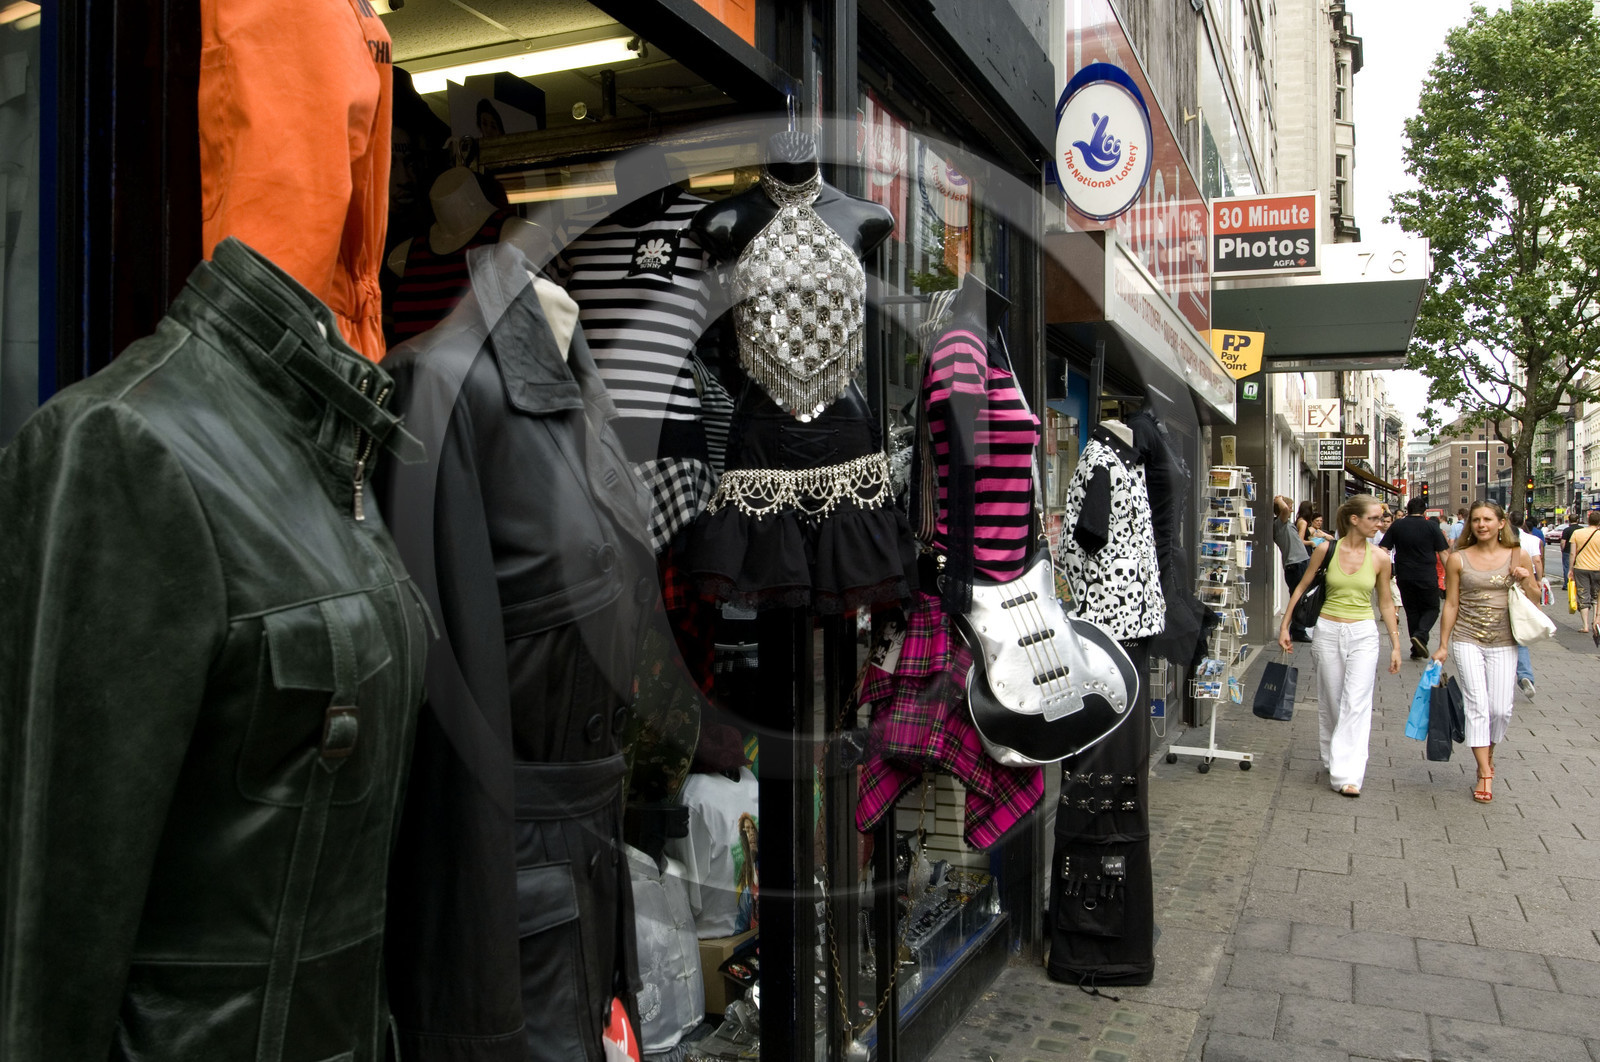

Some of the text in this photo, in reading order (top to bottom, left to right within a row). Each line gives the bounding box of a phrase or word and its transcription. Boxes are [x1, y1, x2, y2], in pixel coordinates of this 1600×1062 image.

[1064, 145, 1139, 188] The National Lottery
[1219, 204, 1310, 229] 30 Minute
[1218, 236, 1310, 259] Photos
[1273, 259, 1296, 267] AGFA
[1357, 250, 1407, 276] 76
[1221, 352, 1240, 363] Pay
[1308, 404, 1336, 428] EX
